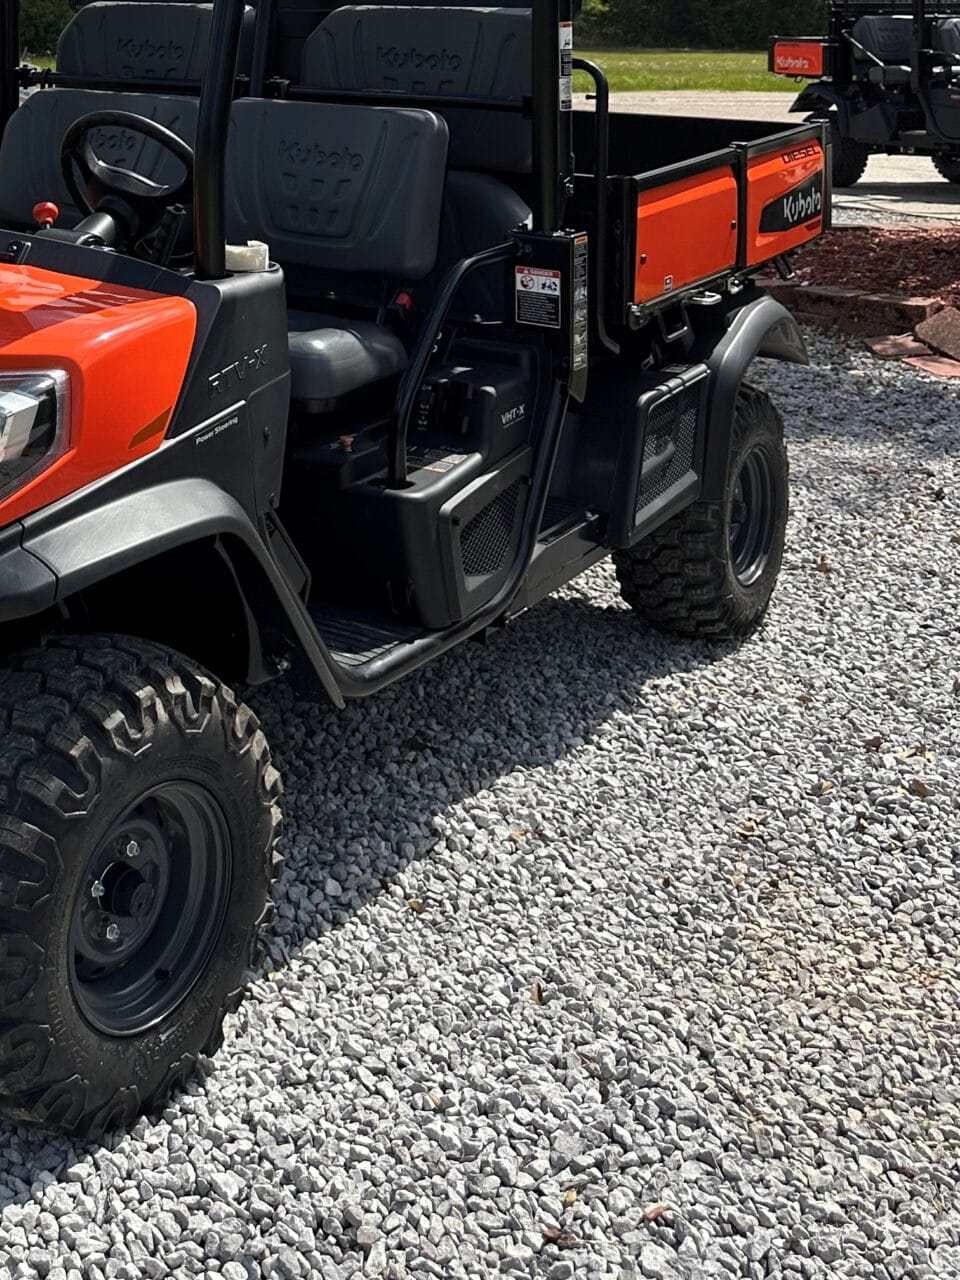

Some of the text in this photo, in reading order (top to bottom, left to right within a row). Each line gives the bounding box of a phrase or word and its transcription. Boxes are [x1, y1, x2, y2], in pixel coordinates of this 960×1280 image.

[117, 37, 186, 60] Kubota
[376, 45, 464, 72] Kubota
[776, 55, 809, 69] Kubota
[279, 140, 364, 172] Kubota
[781, 146, 821, 164] DIESEL
[783, 187, 822, 223] Kubota
[208, 343, 269, 399] RTV-X
[196, 416, 239, 445] Power Steering
